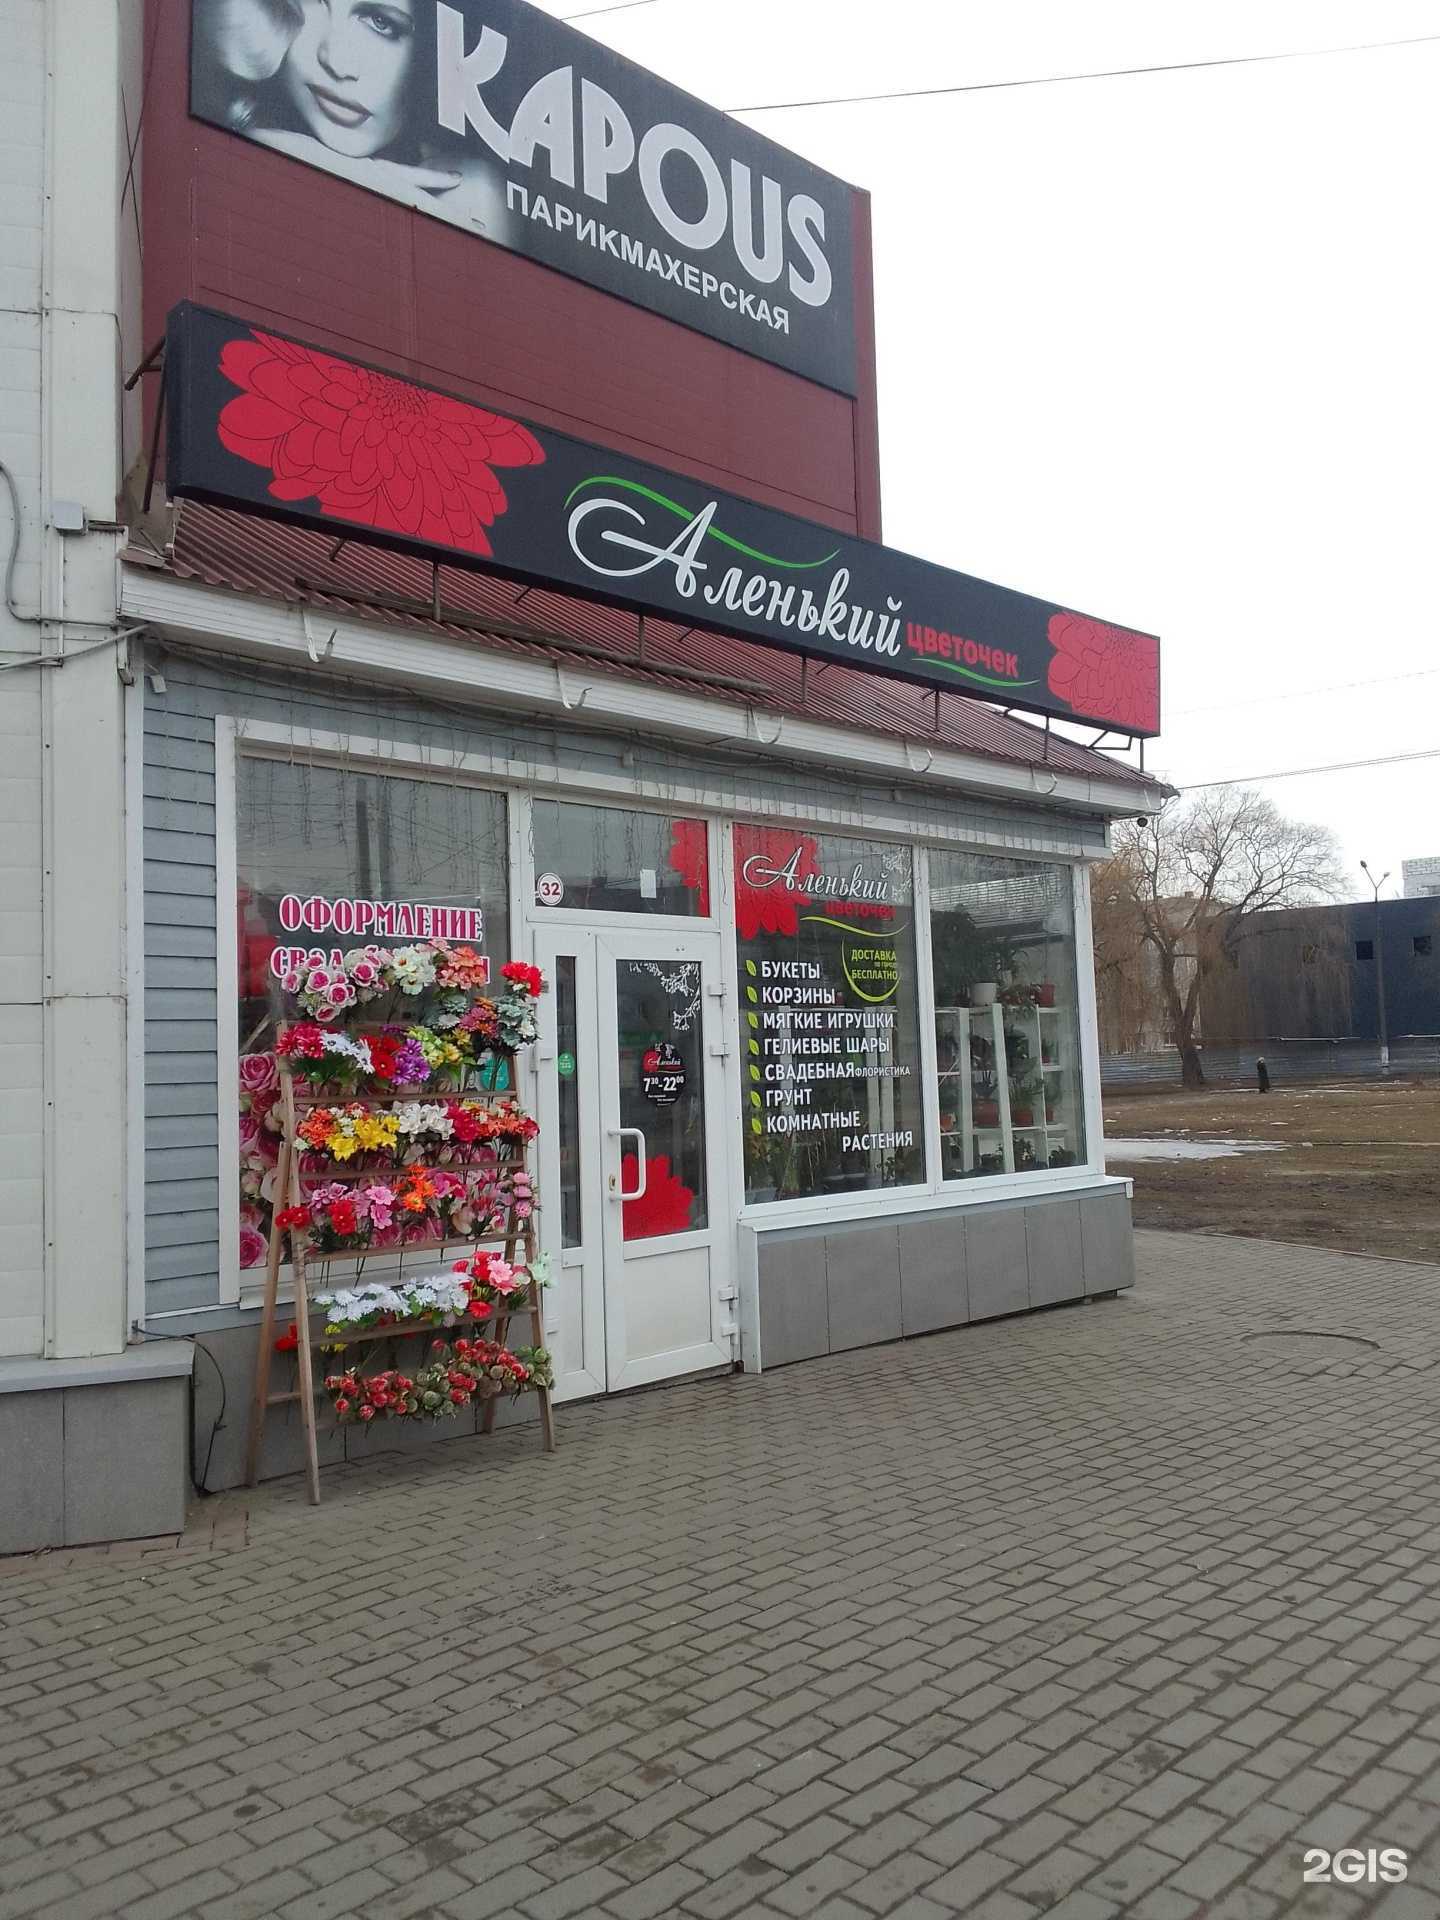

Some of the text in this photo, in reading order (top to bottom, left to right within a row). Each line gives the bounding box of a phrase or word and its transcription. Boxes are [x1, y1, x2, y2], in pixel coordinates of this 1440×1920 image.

[436, 1, 832, 307] KAPOUS
[506, 180, 790, 335] ПАРИКМАХЕРСКАЯ
[567, 498, 902, 657] Аленький
[742, 846, 890, 901] Аленький
[541, 882, 561, 897] 32
[279, 894, 483, 942] ОФОРМЛЕНИЕ
[851, 949, 897, 961] ДОСТАВКА
[761, 961, 820, 979] БУКЕТЫ
[851, 969, 898, 980] БЕСПЛАТНО
[762, 986, 835, 1004] КОРЗИНЫ
[763, 1012, 894, 1029] МЯГКИЕ ИГРУШКИ
[764, 1038, 890, 1055] ГЕЛИЕВЫЕ ШАРЫ
[764, 1063, 911, 1082] СВАДЕБНАЯ ФЛОРИСТИКА
[766, 1088, 812, 1107] ГРУНТ
[767, 1111, 860, 1133] КОМНАТНЫЕ
[842, 1131, 913, 1152] РАСТЕНИЯ
